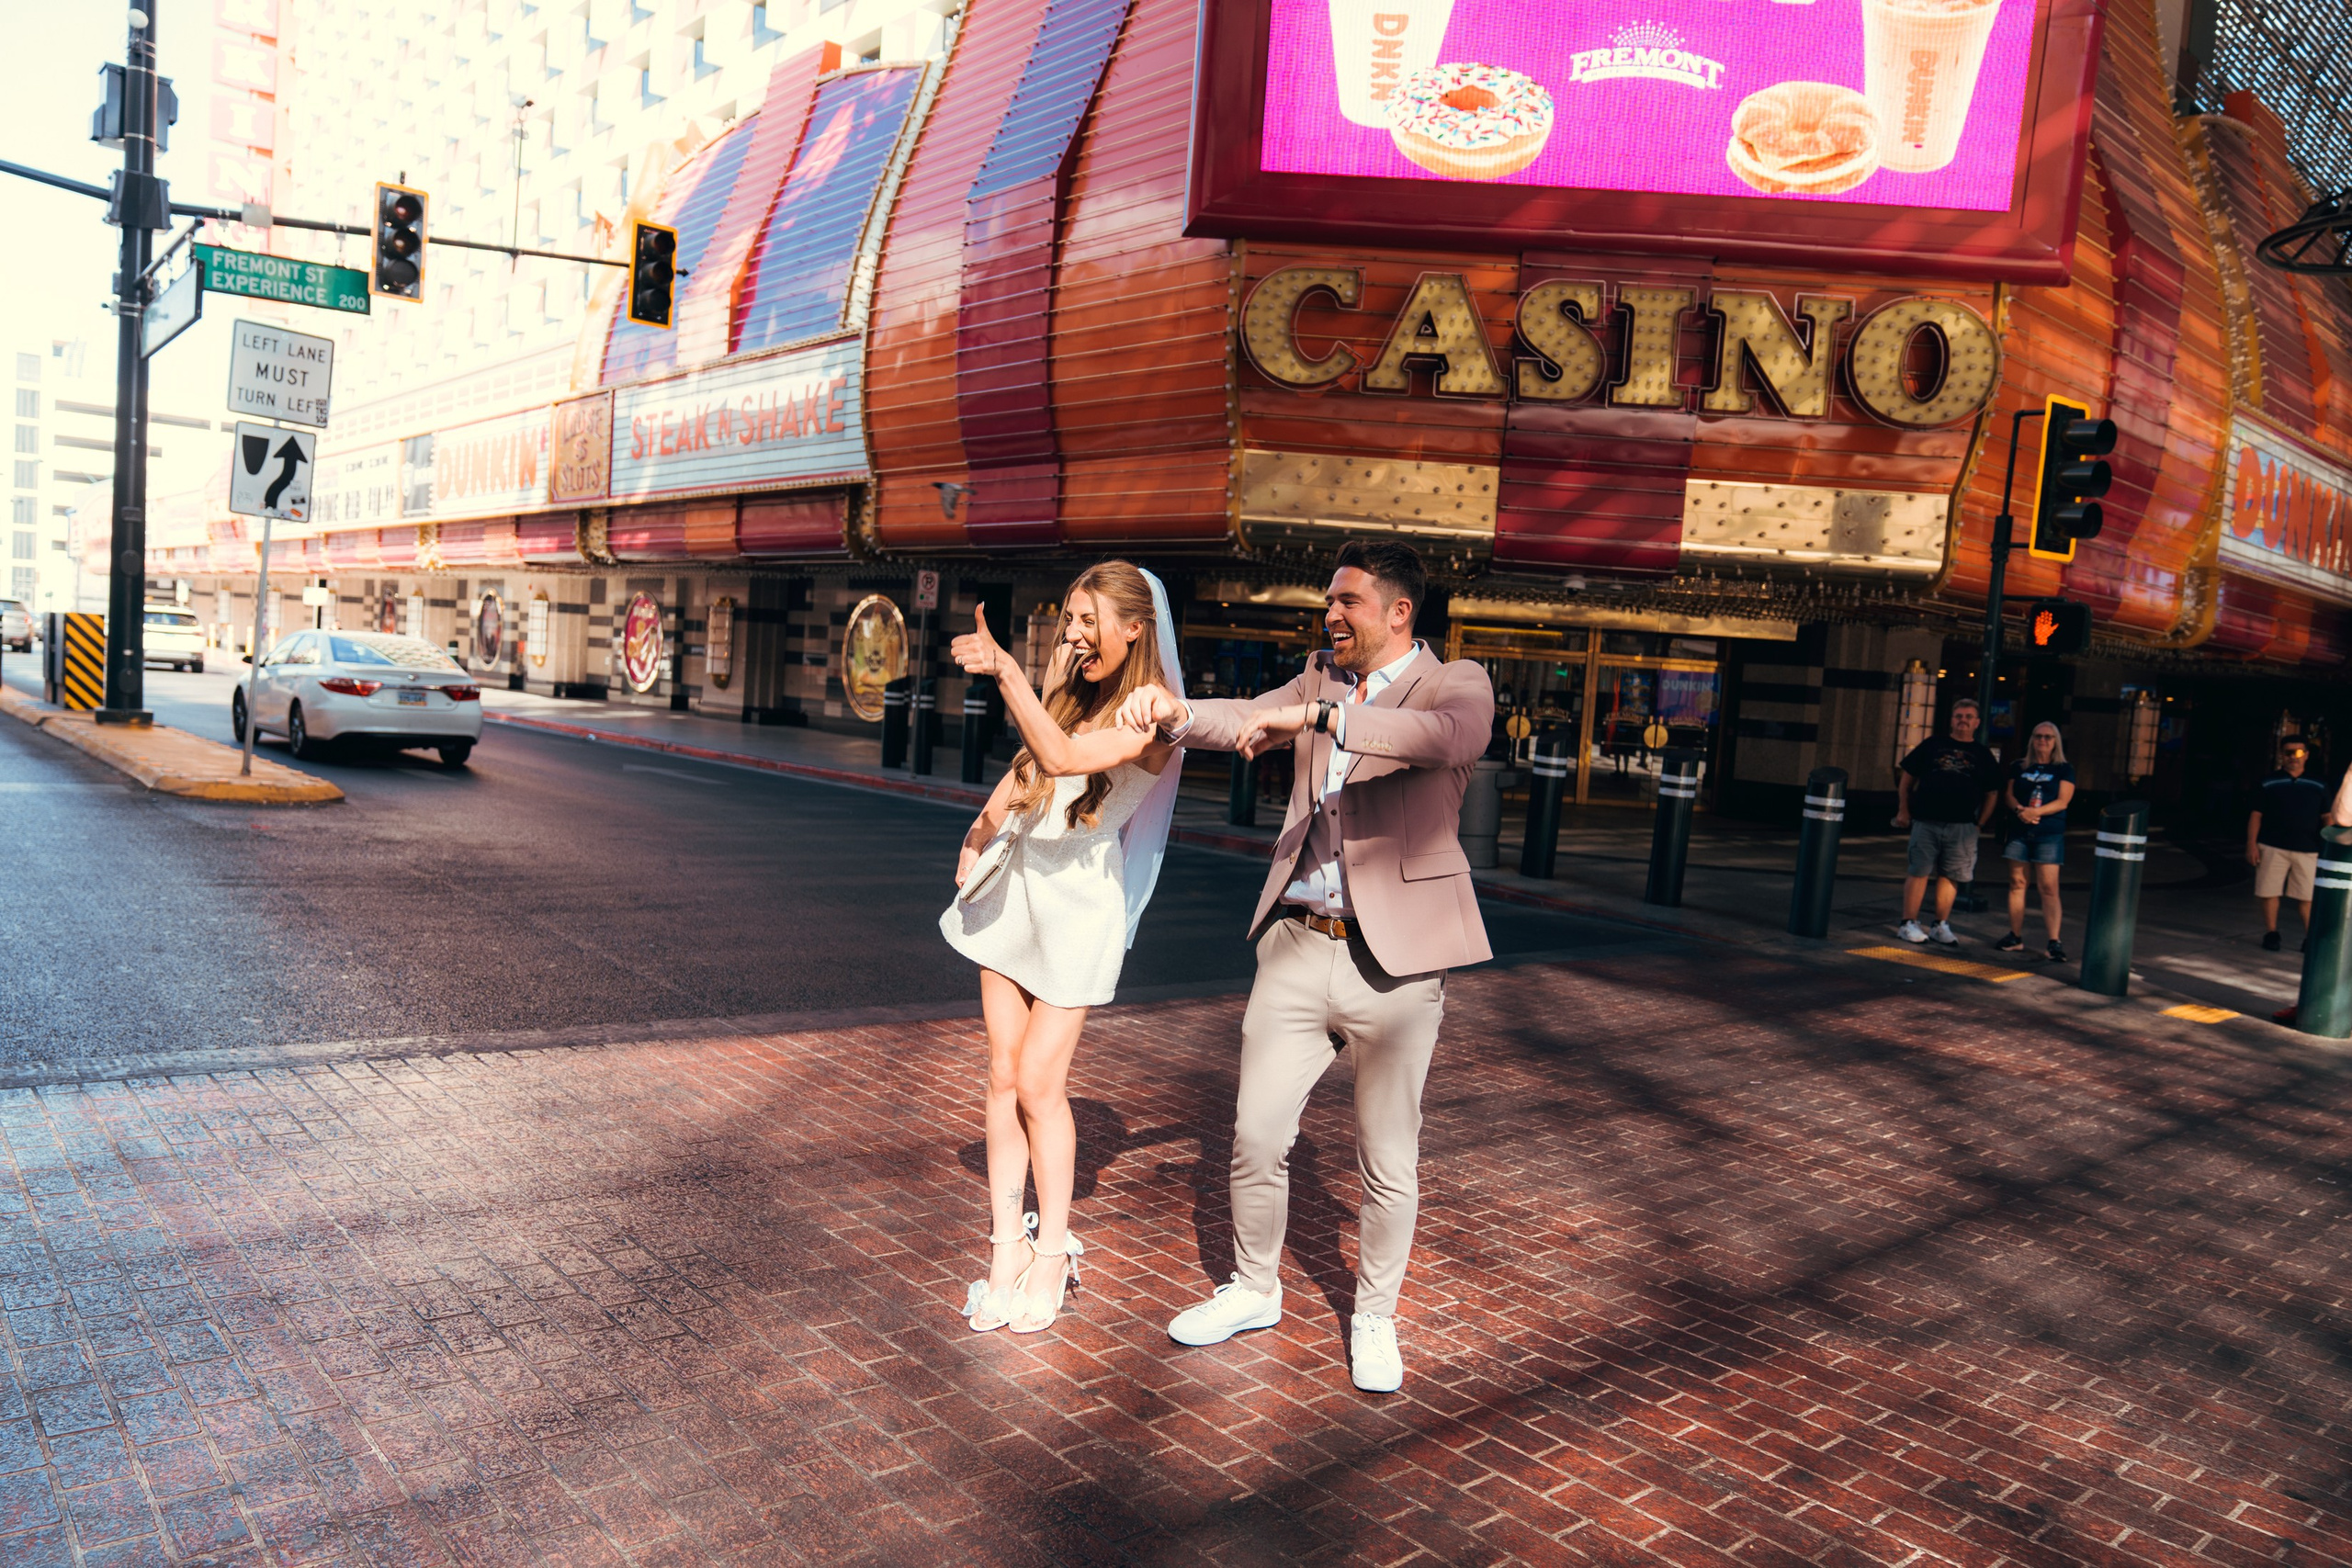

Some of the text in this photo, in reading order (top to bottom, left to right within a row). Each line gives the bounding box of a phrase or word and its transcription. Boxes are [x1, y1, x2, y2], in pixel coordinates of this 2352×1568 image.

[1370, 13, 1409, 101] DNKN
[1569, 47, 1725, 89] FREMONT
[212, 251, 327, 284] FREMONT ST
[211, 271, 366, 310] EXPERIENCE 200
[243, 333, 325, 364] LEFT LANE
[1240, 265, 2004, 429] CASINO
[256, 362, 309, 388] MUST
[237, 386, 276, 407] TURN
[288, 397, 317, 413] LEF
[631, 402, 710, 460] STEAK
[739, 377, 848, 446] SHAKE
[436, 425, 547, 501] DUNKIN'
[560, 459, 602, 492] SLOTS
[1662, 679, 1714, 692] DUNKIN'
